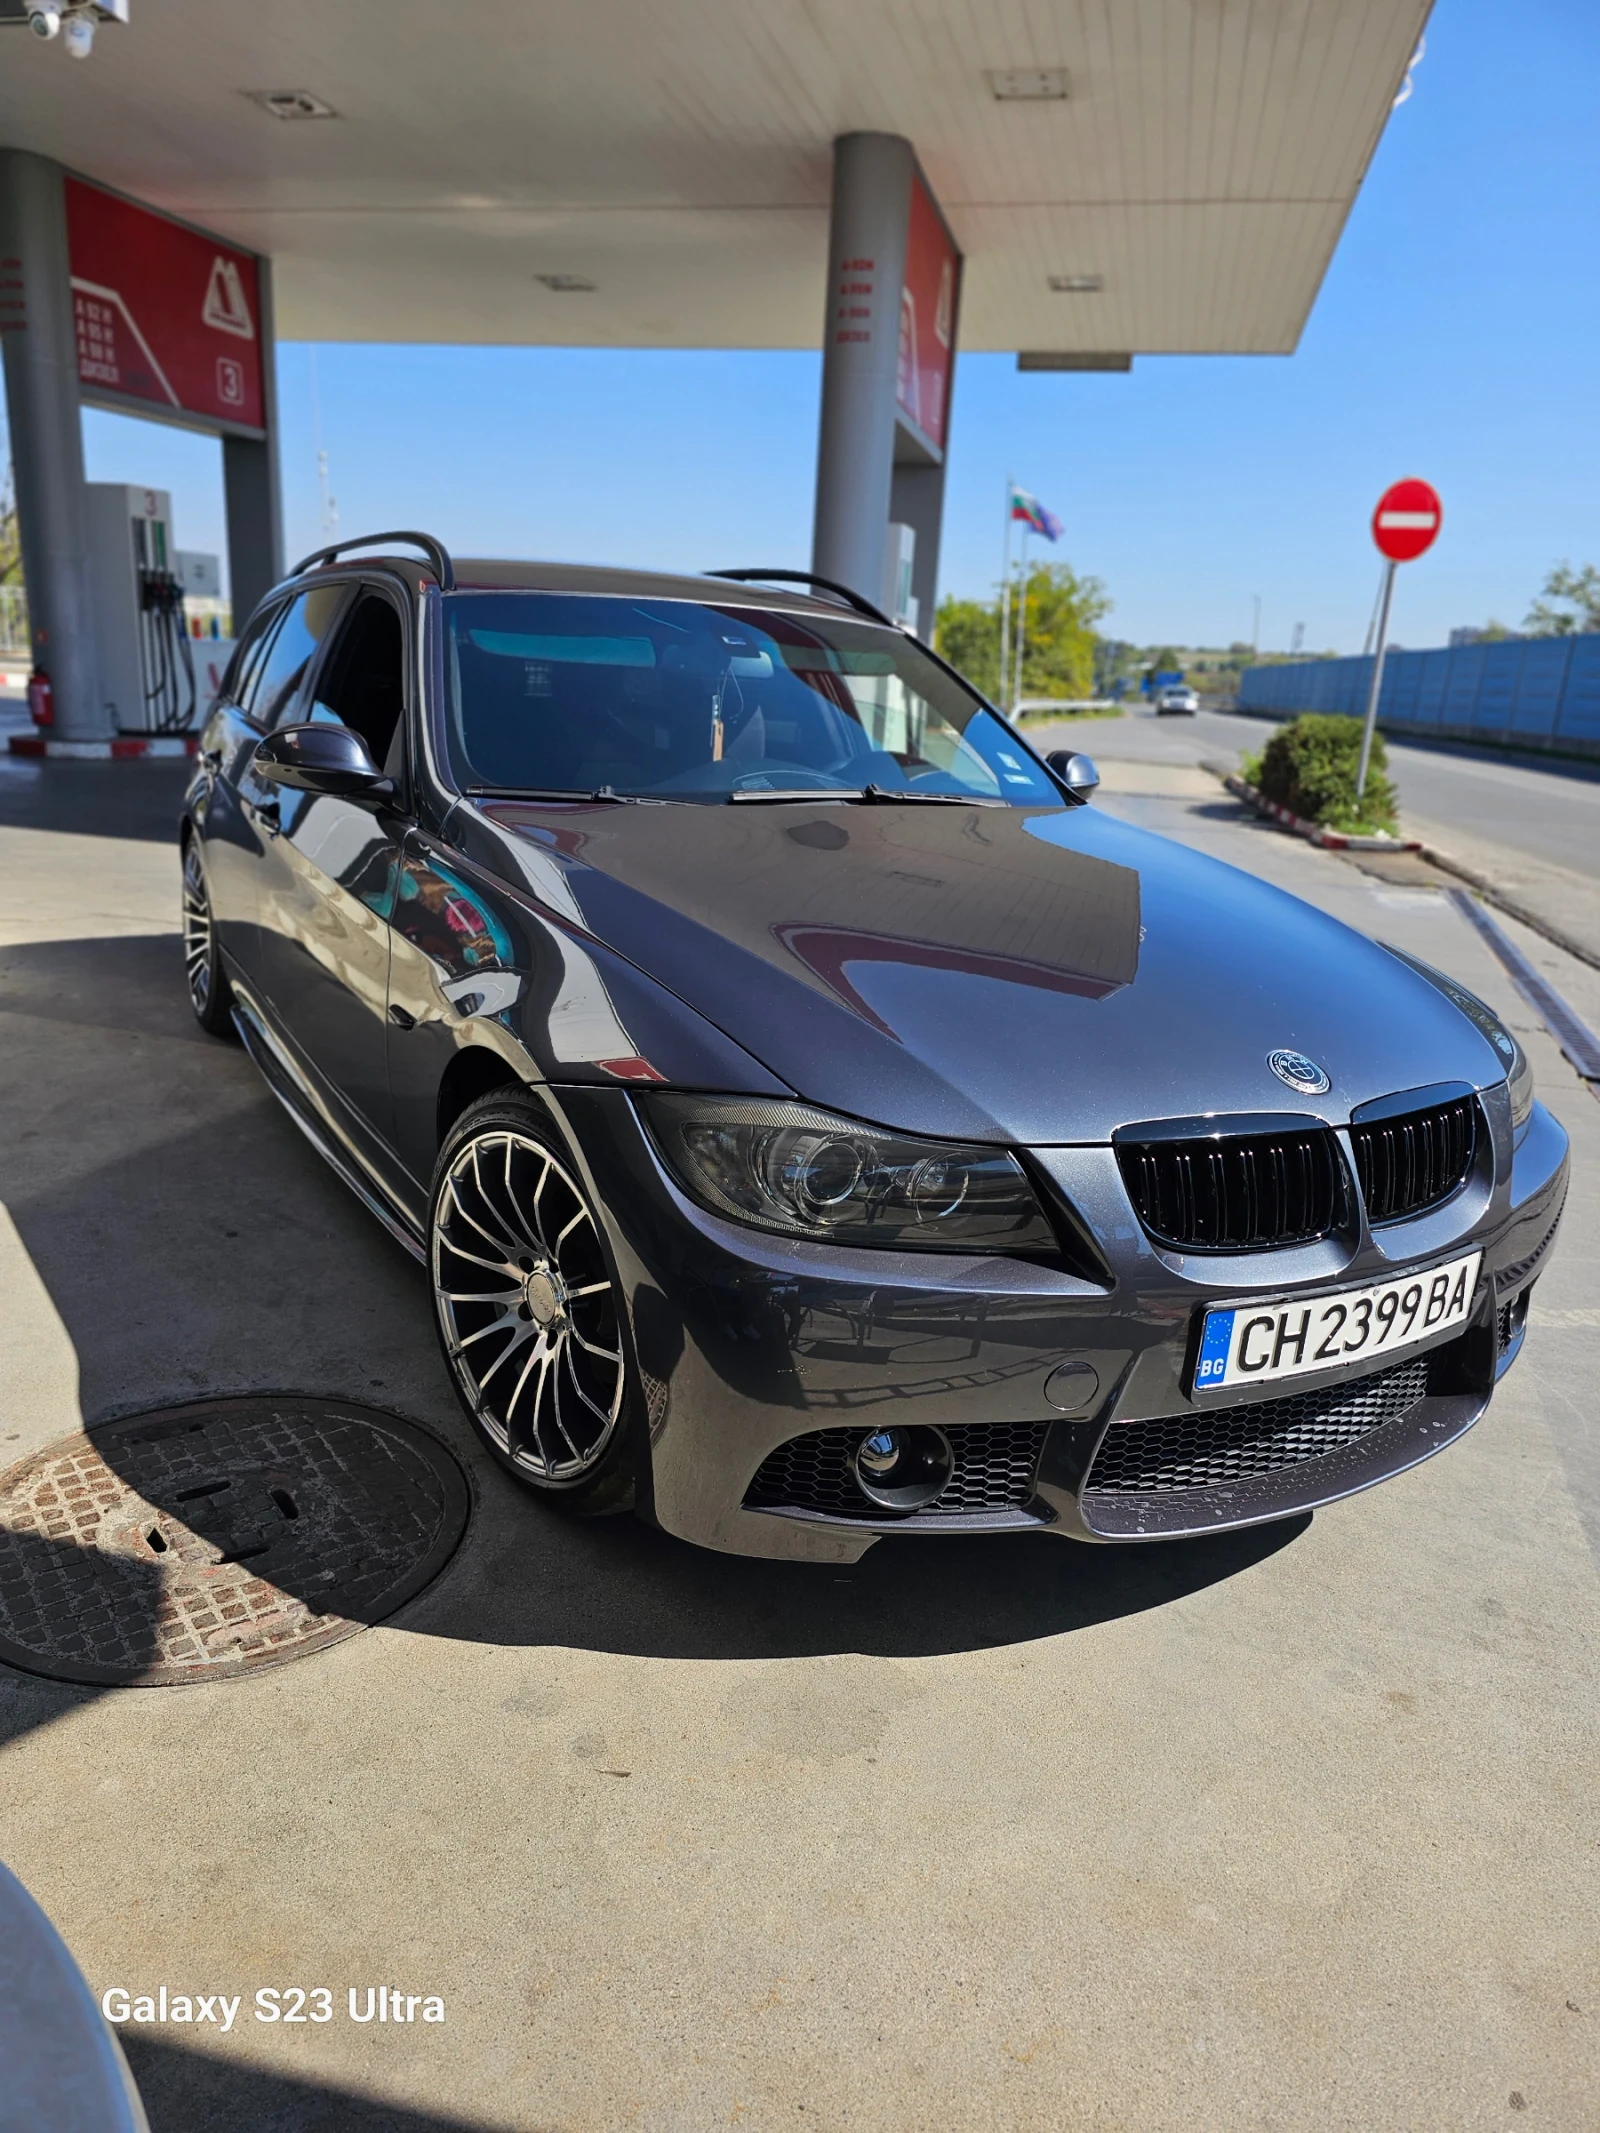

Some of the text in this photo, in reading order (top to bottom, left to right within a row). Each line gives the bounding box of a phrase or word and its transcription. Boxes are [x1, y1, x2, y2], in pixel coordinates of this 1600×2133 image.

[223, 366, 237, 399] 3
[144, 490, 157, 517] 3
[1200, 1357, 1225, 1378] BG
